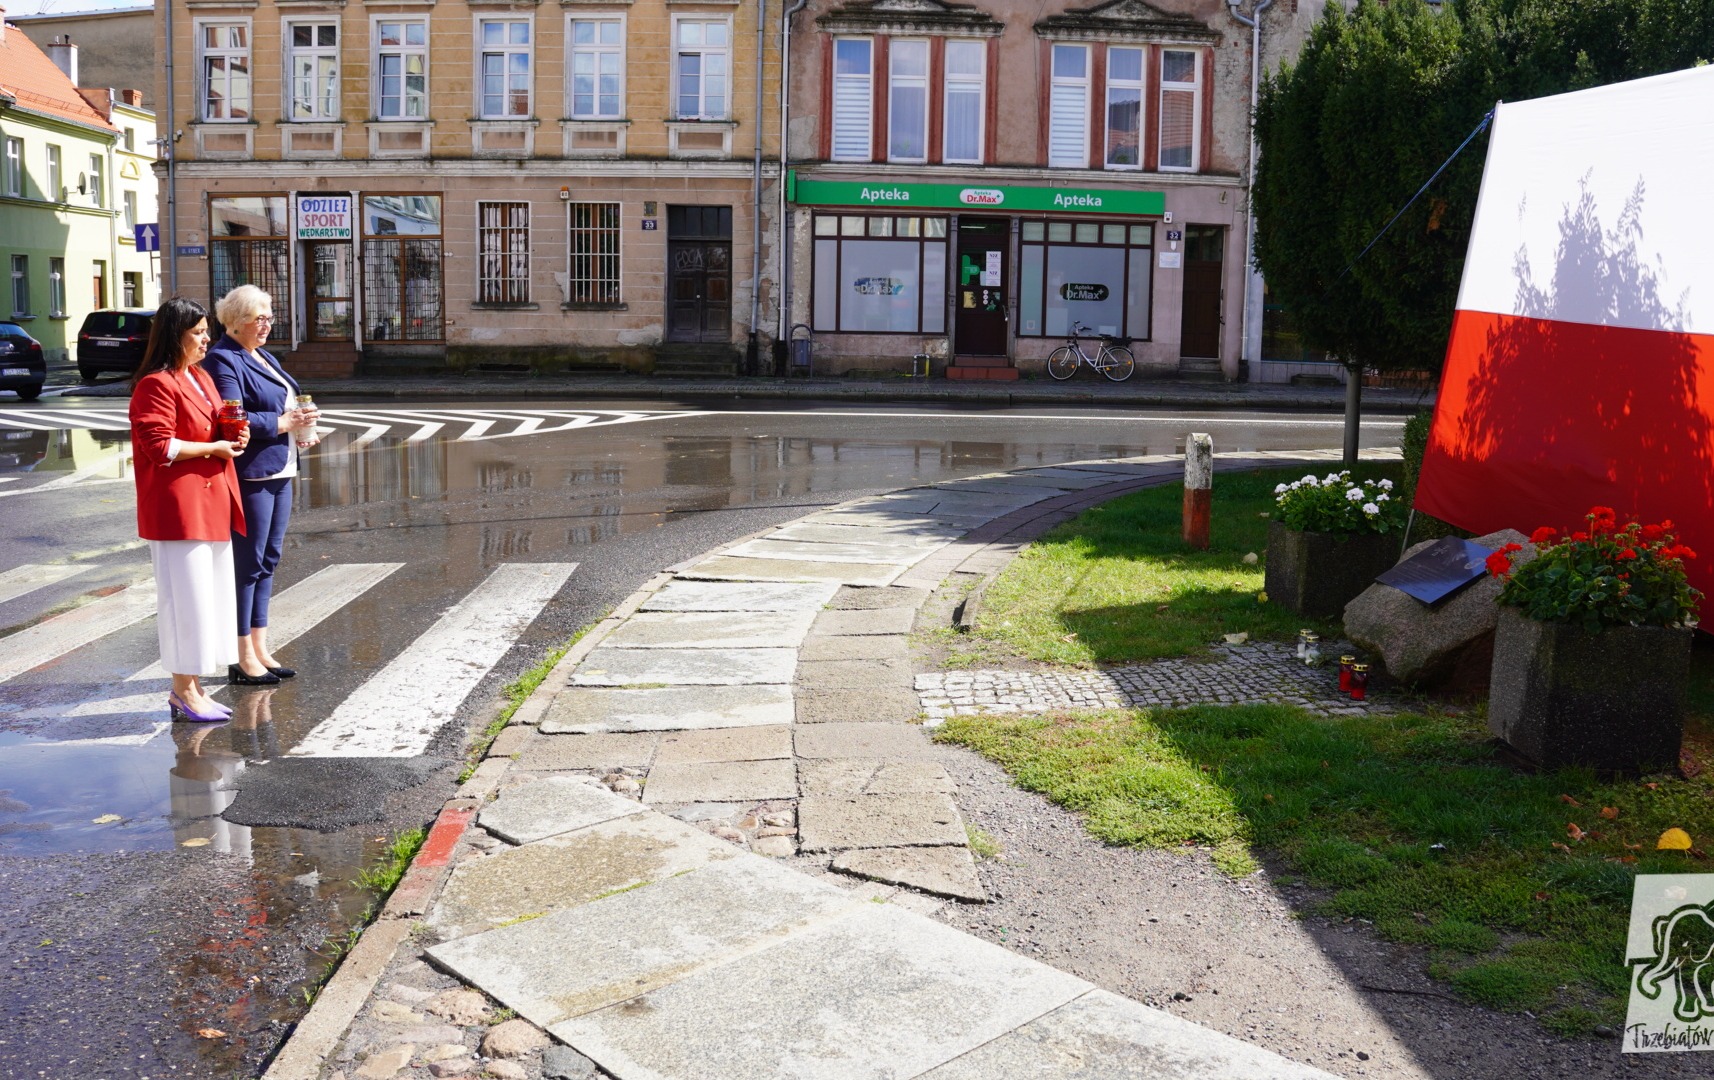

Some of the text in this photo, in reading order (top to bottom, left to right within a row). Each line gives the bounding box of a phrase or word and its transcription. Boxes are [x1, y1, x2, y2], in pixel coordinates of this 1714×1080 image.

[860, 187, 910, 202] Apteka
[966, 194, 997, 203] Dr.Max
[1053, 193, 1103, 208] Apteka
[304, 214, 345, 228] SPORT
[299, 228, 350, 238] WĘDKARSTWO
[1067, 290, 1100, 300] Dr.Max
